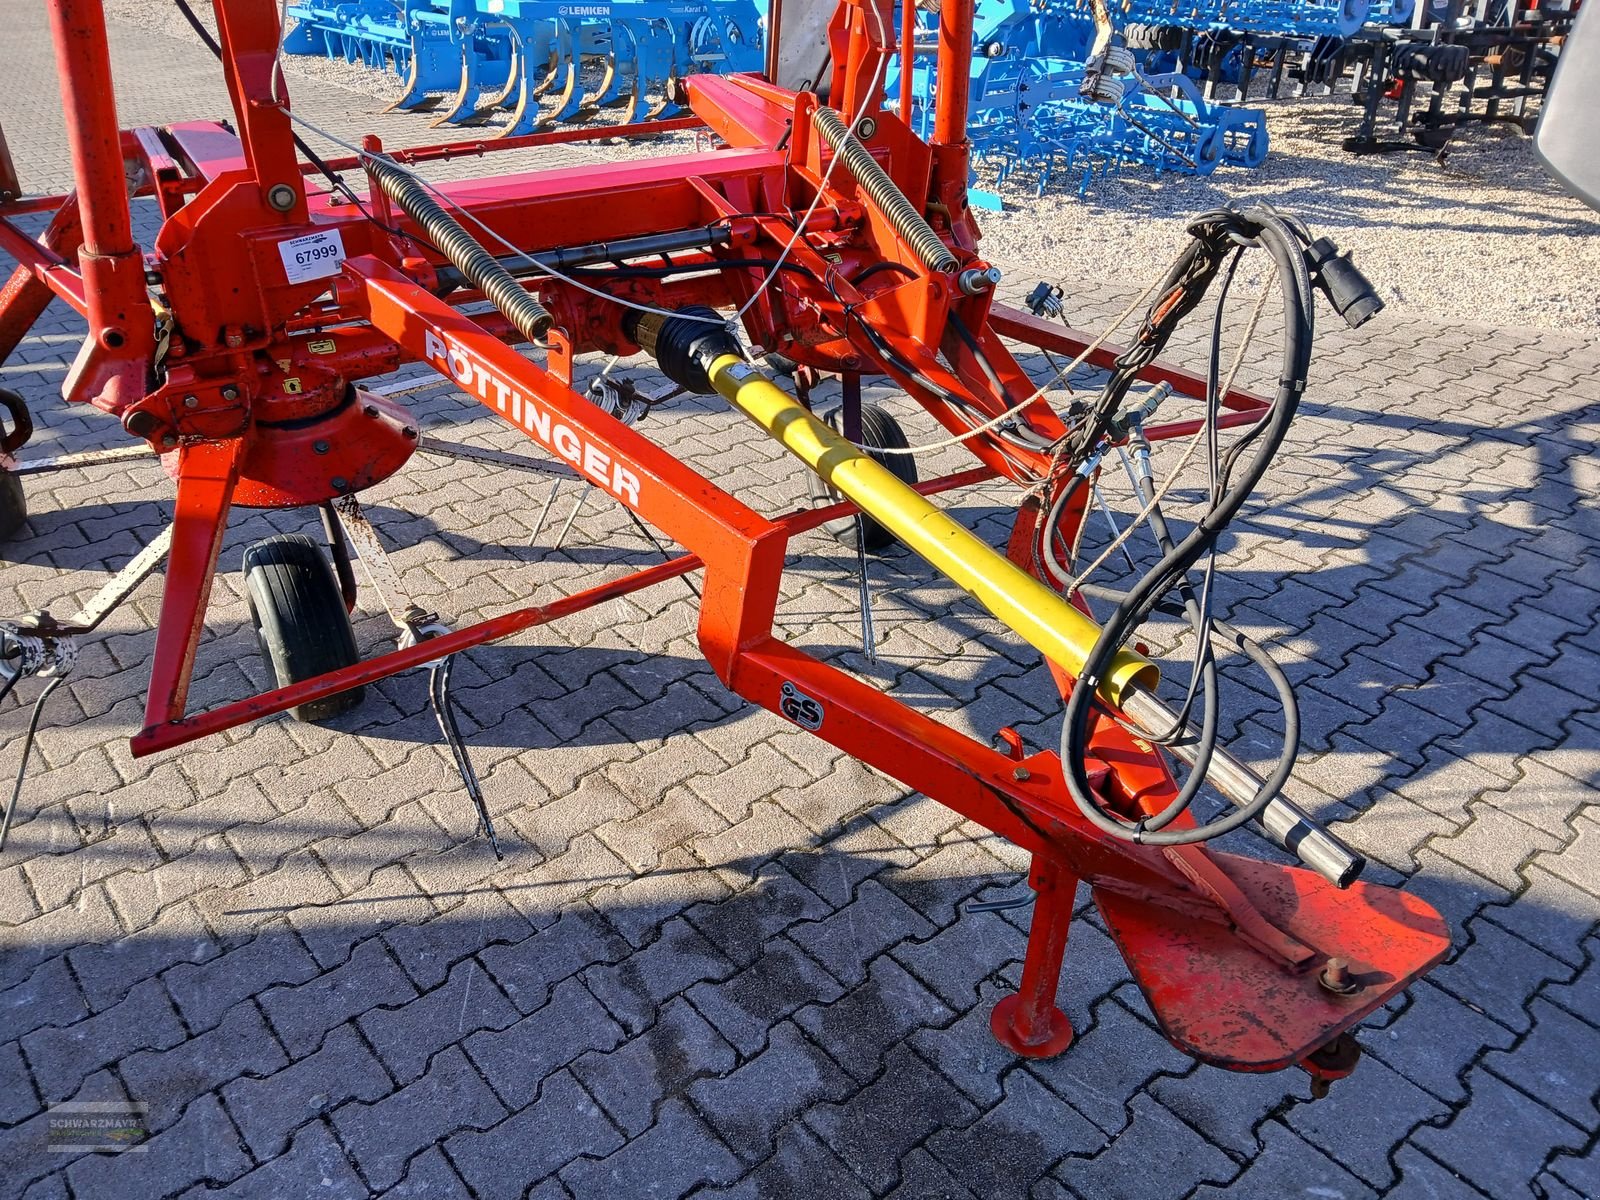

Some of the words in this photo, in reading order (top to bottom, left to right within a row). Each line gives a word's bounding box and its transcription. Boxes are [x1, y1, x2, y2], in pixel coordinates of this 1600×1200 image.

[569, 6, 610, 16] LEMKEN
[684, 5, 701, 13] Karat
[289, 234, 324, 246] SCHWARZMAYR
[295, 244, 338, 264] 67999
[425, 329, 641, 508] PÖTTINGER
[782, 697, 820, 724] GS
